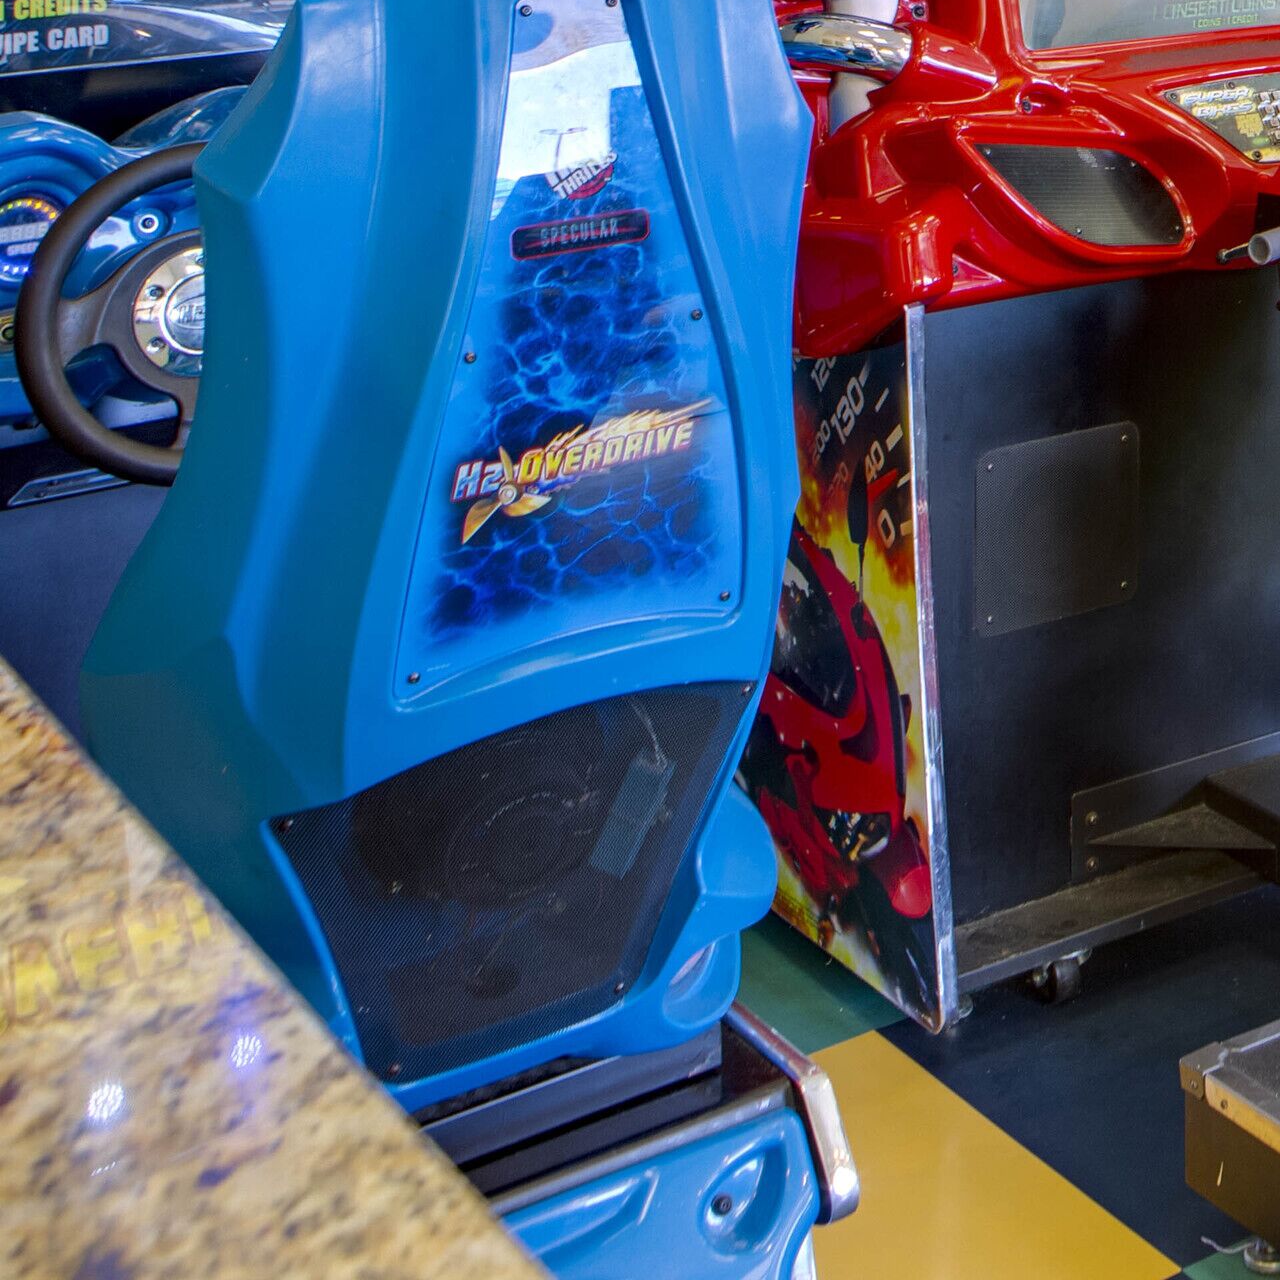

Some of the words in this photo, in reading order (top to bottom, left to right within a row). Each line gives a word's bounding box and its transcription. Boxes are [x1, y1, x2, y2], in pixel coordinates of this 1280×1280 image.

[47, 24, 110, 50] CARD
[1186, 87, 1249, 105] SUPER
[553, 152, 618, 199] THRILLS
[540, 219, 619, 247] SPECULAR
[831, 376, 865, 445] 130
[517, 422, 693, 485] OVERDRIVE
